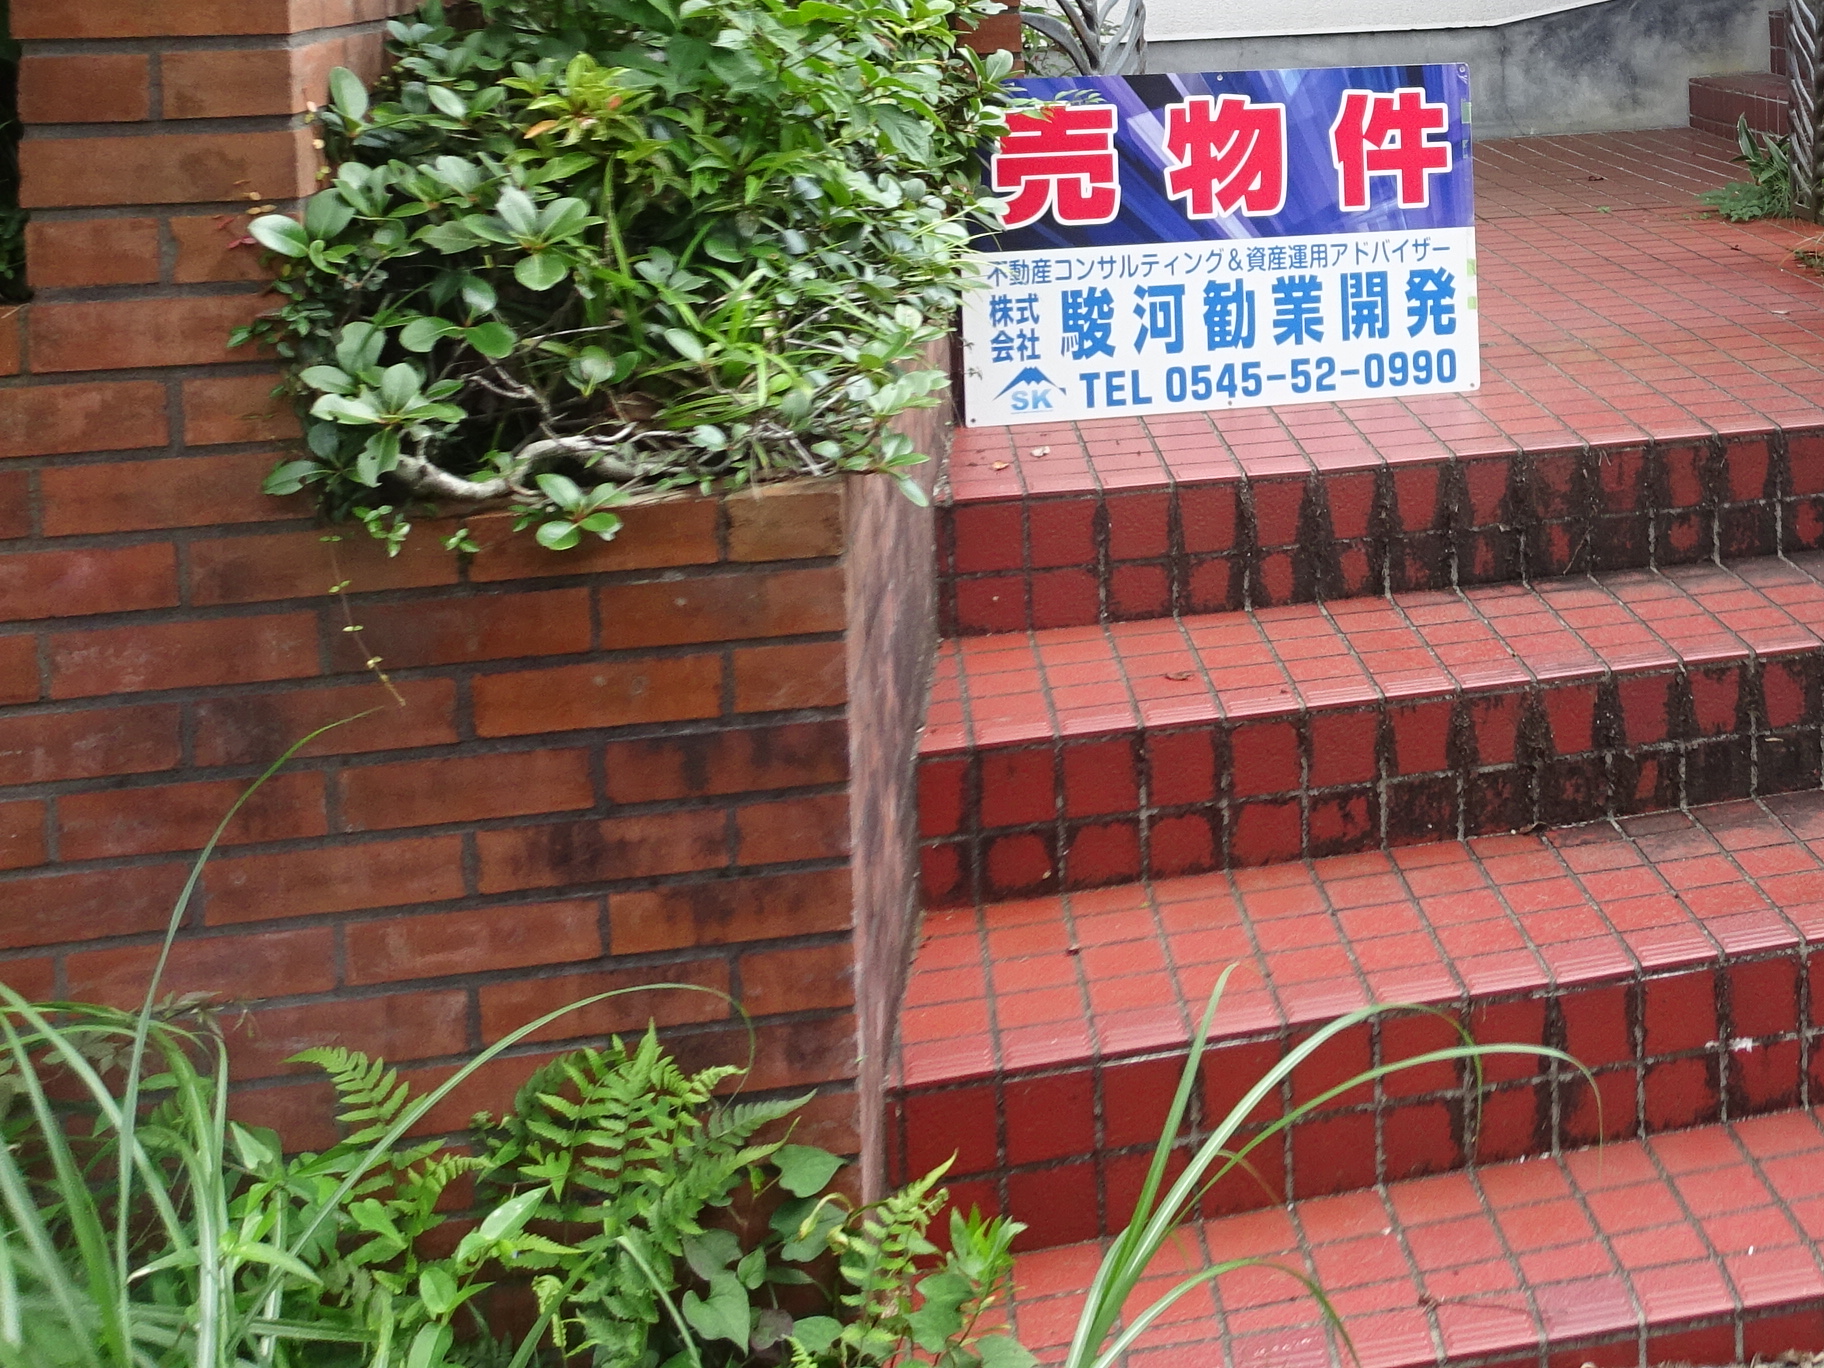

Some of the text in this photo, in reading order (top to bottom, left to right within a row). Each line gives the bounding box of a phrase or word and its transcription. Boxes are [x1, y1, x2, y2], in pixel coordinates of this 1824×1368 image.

[992, 87, 1452, 229] 売物件
[987, 236, 1451, 287] 不動産コンサルティング&資産運用アドバイザー
[989, 292, 1040, 328] 株式
[1061, 266, 1457, 361] 駿河勧業開発
[990, 328, 1042, 363] 会社
[1010, 389, 1054, 411] SK
[1079, 348, 1457, 409] TEL 0545-52-0990
